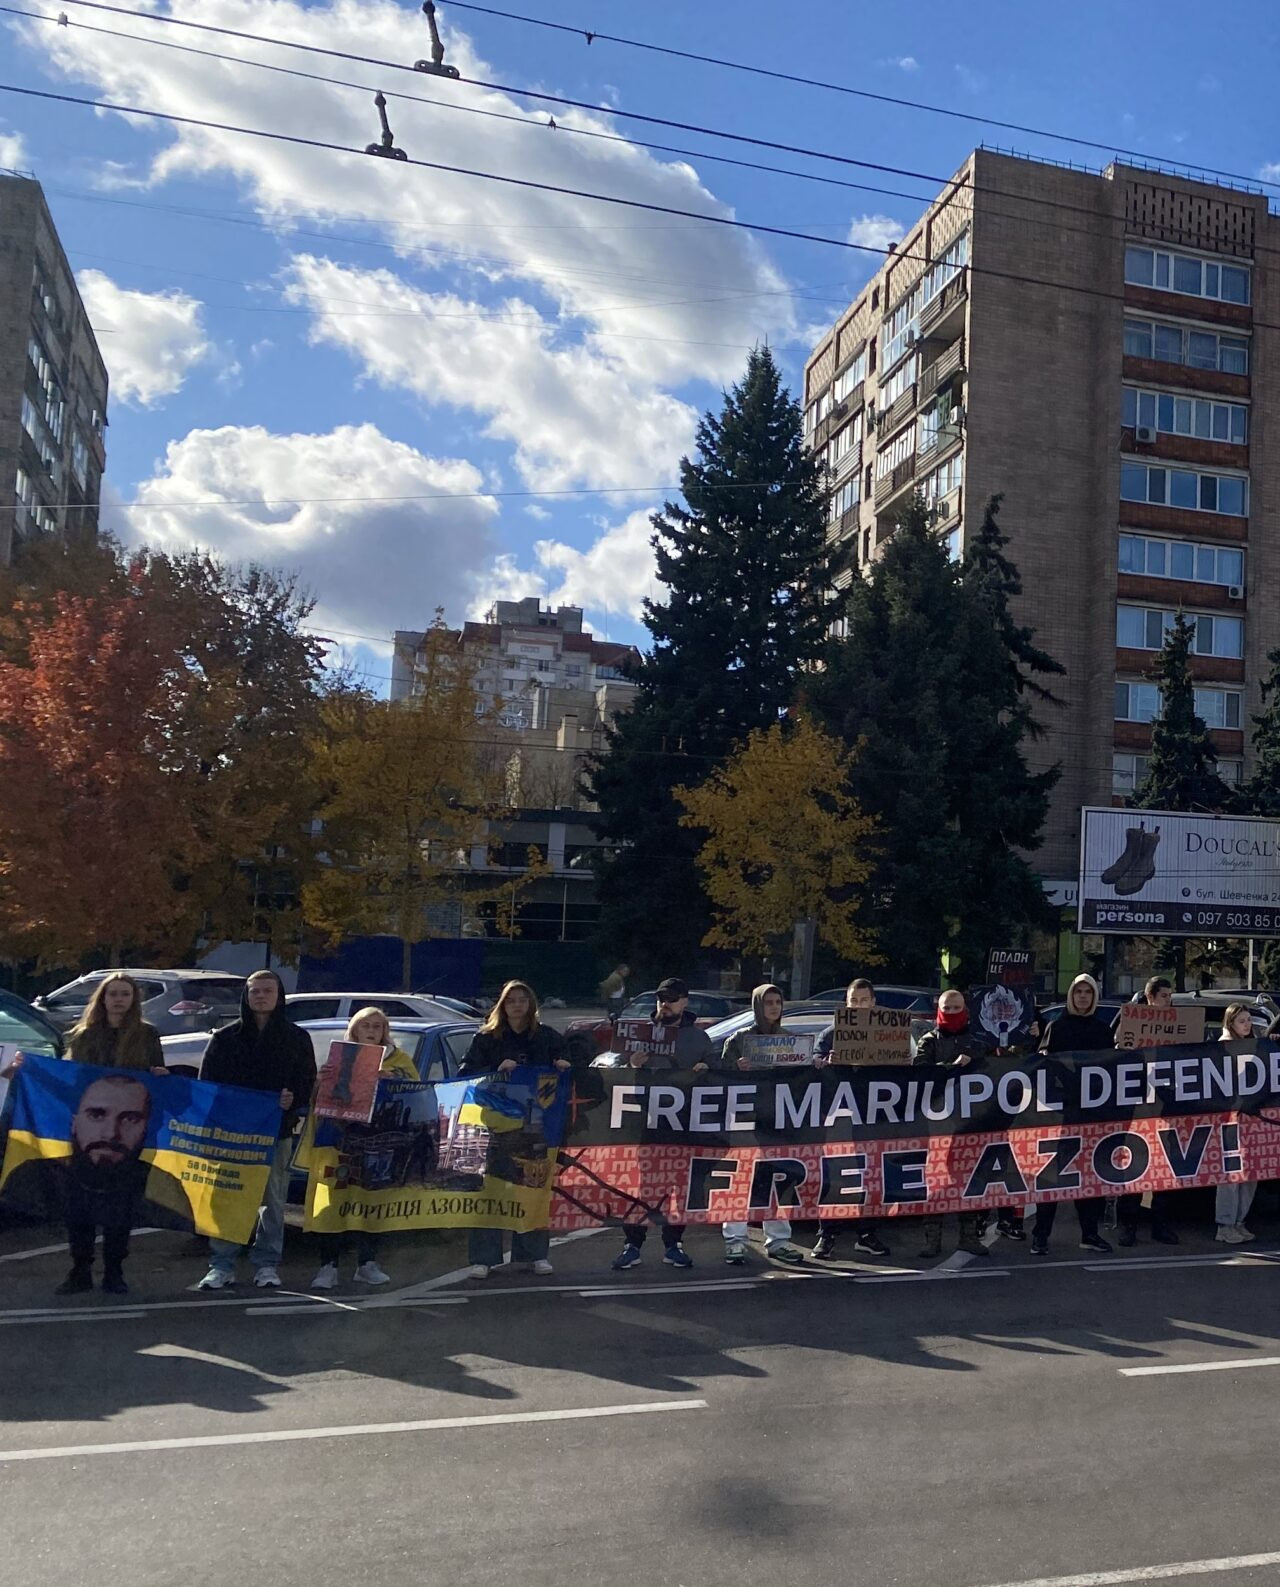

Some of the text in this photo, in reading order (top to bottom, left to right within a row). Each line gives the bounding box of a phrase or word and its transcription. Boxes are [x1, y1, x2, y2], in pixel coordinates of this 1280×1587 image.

[1219, 889, 1270, 902] Шевченка
[1096, 903, 1129, 912] магазин
[1096, 909, 1165, 924] persona
[1197, 911, 1222, 925] 097
[1226, 913, 1250, 926] 503
[1254, 914, 1270, 927] 85
[991, 951, 1029, 963] ПОЛОН
[838, 1008, 912, 1028] НЕ МОВЧИ
[616, 1022, 638, 1039] НЕ
[836, 1029, 868, 1042] ПОЛОН
[1140, 1023, 1187, 1035] ГІРШЕ
[610, 1085, 757, 1131] FREE
[775, 1069, 1063, 1129] MARIUPOL
[685, 1121, 1243, 1212] FREE AZOV!
[338, 1197, 525, 1221] ФОРТЕЦЯ АЗОВСТАЛЬ
